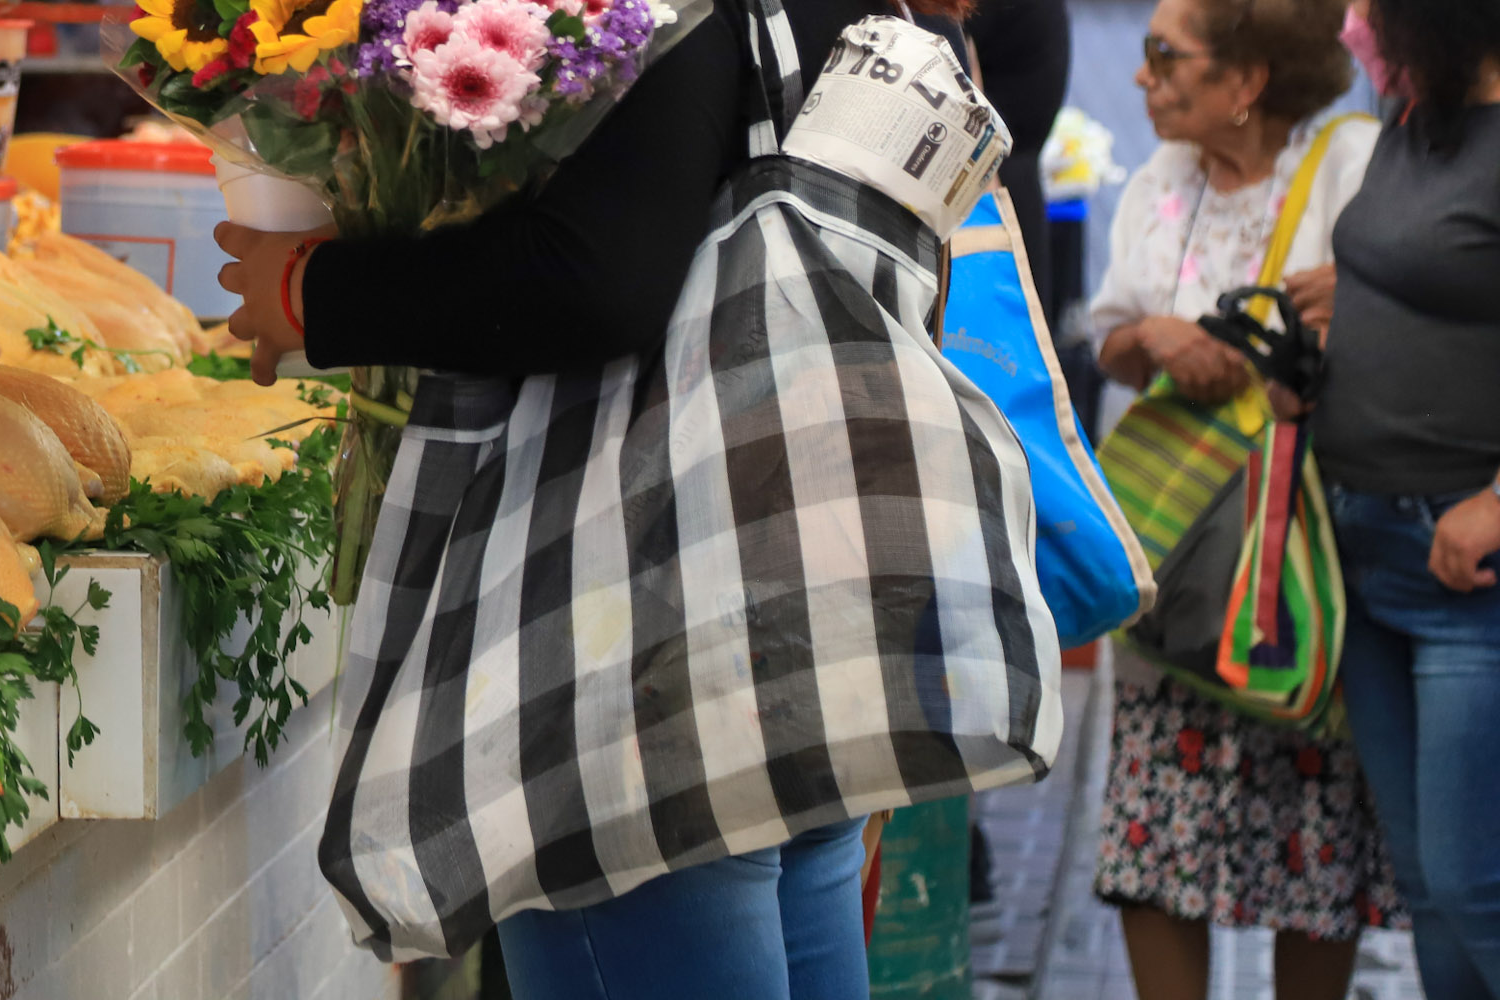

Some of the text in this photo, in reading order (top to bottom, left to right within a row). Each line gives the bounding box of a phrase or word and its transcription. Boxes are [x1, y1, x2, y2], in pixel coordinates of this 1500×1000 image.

[872, 58, 904, 84] 8
[911, 79, 949, 110] 7
[912, 144, 932, 172] Choferes
